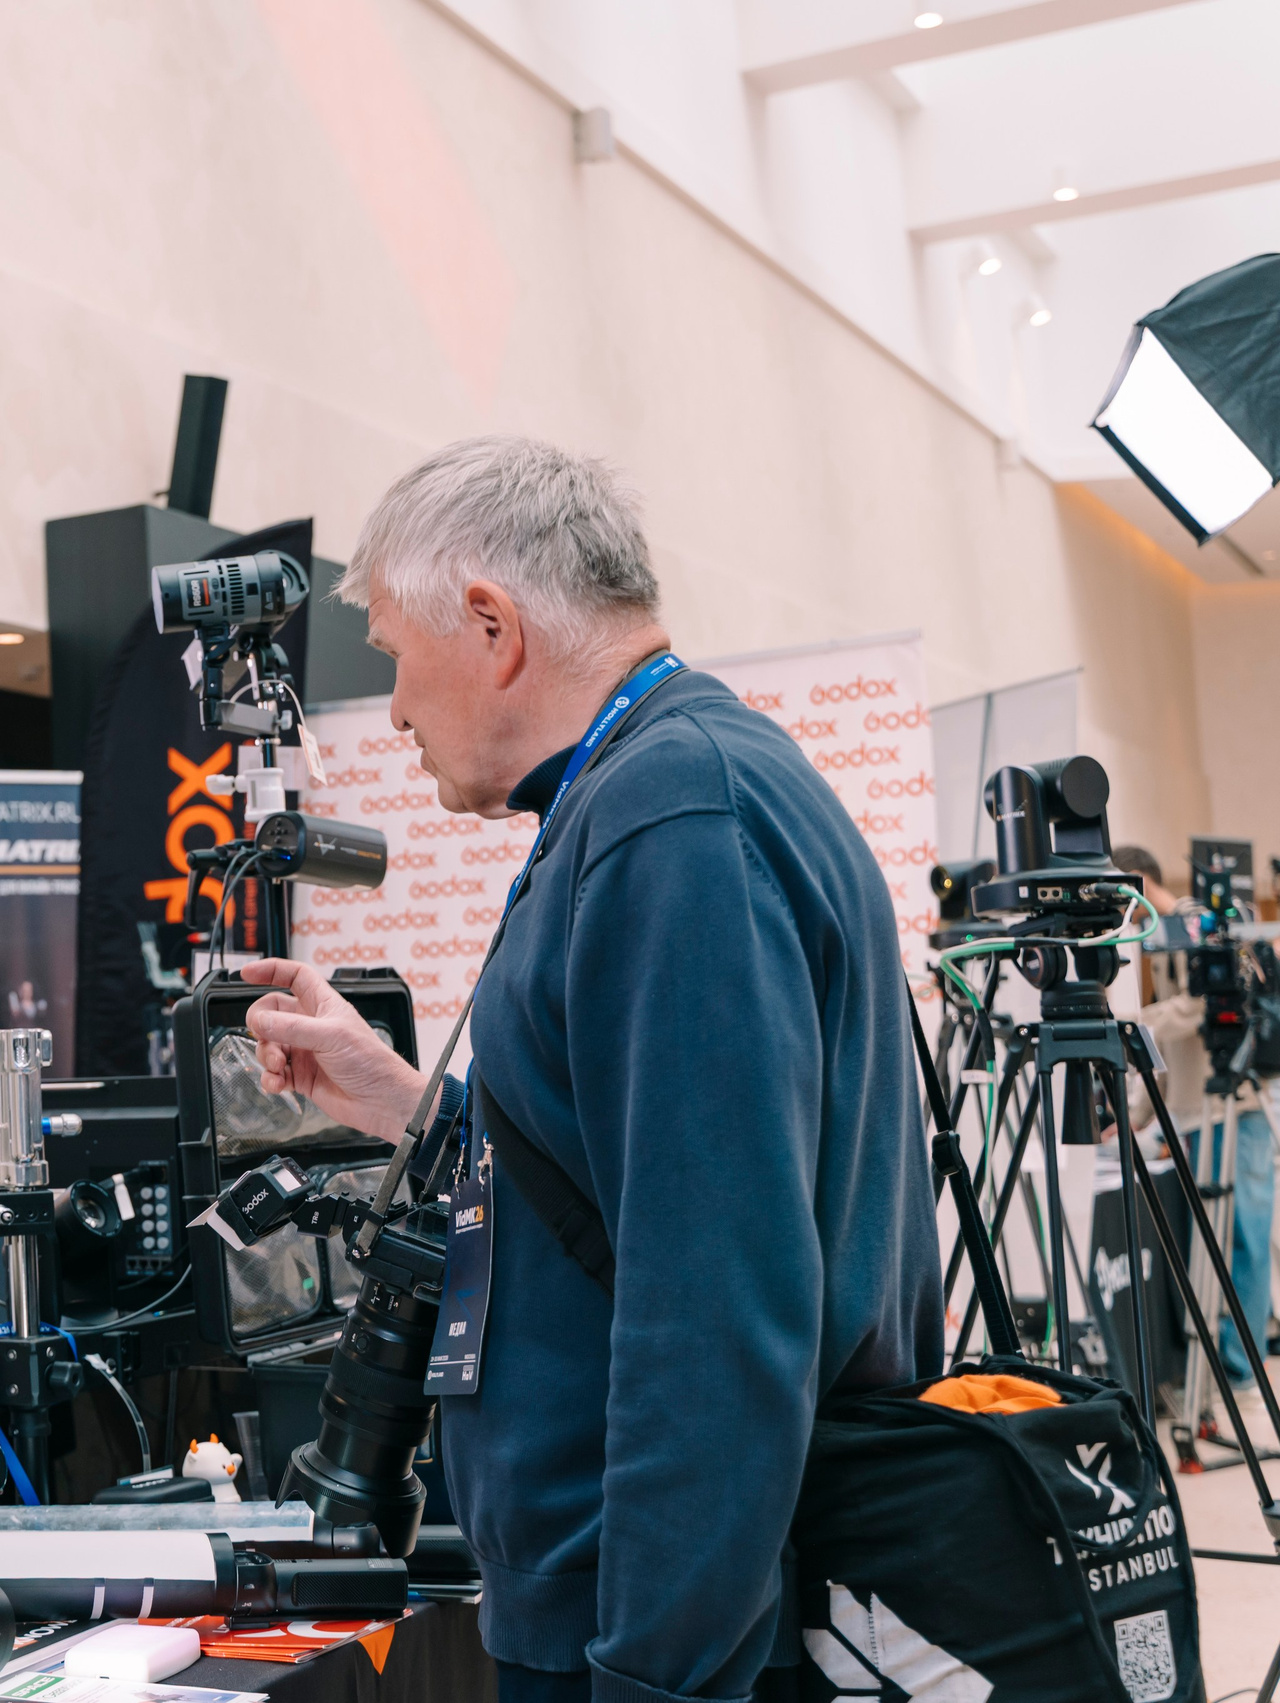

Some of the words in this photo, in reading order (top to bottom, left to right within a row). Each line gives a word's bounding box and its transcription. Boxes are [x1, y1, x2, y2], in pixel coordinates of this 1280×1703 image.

[809, 674, 898, 706] Godox
[585, 707, 618, 748] HOLLYLAND
[813, 741, 902, 772] Godox
[360, 788, 435, 815] Godox
[406, 815, 483, 840] Godox
[409, 873, 487, 900] Godox
[362, 906, 440, 933] Godox
[313, 938, 389, 965] Godox
[455, 1204, 484, 1228] VidMK26
[448, 1321, 467, 1338] МЕДИА
